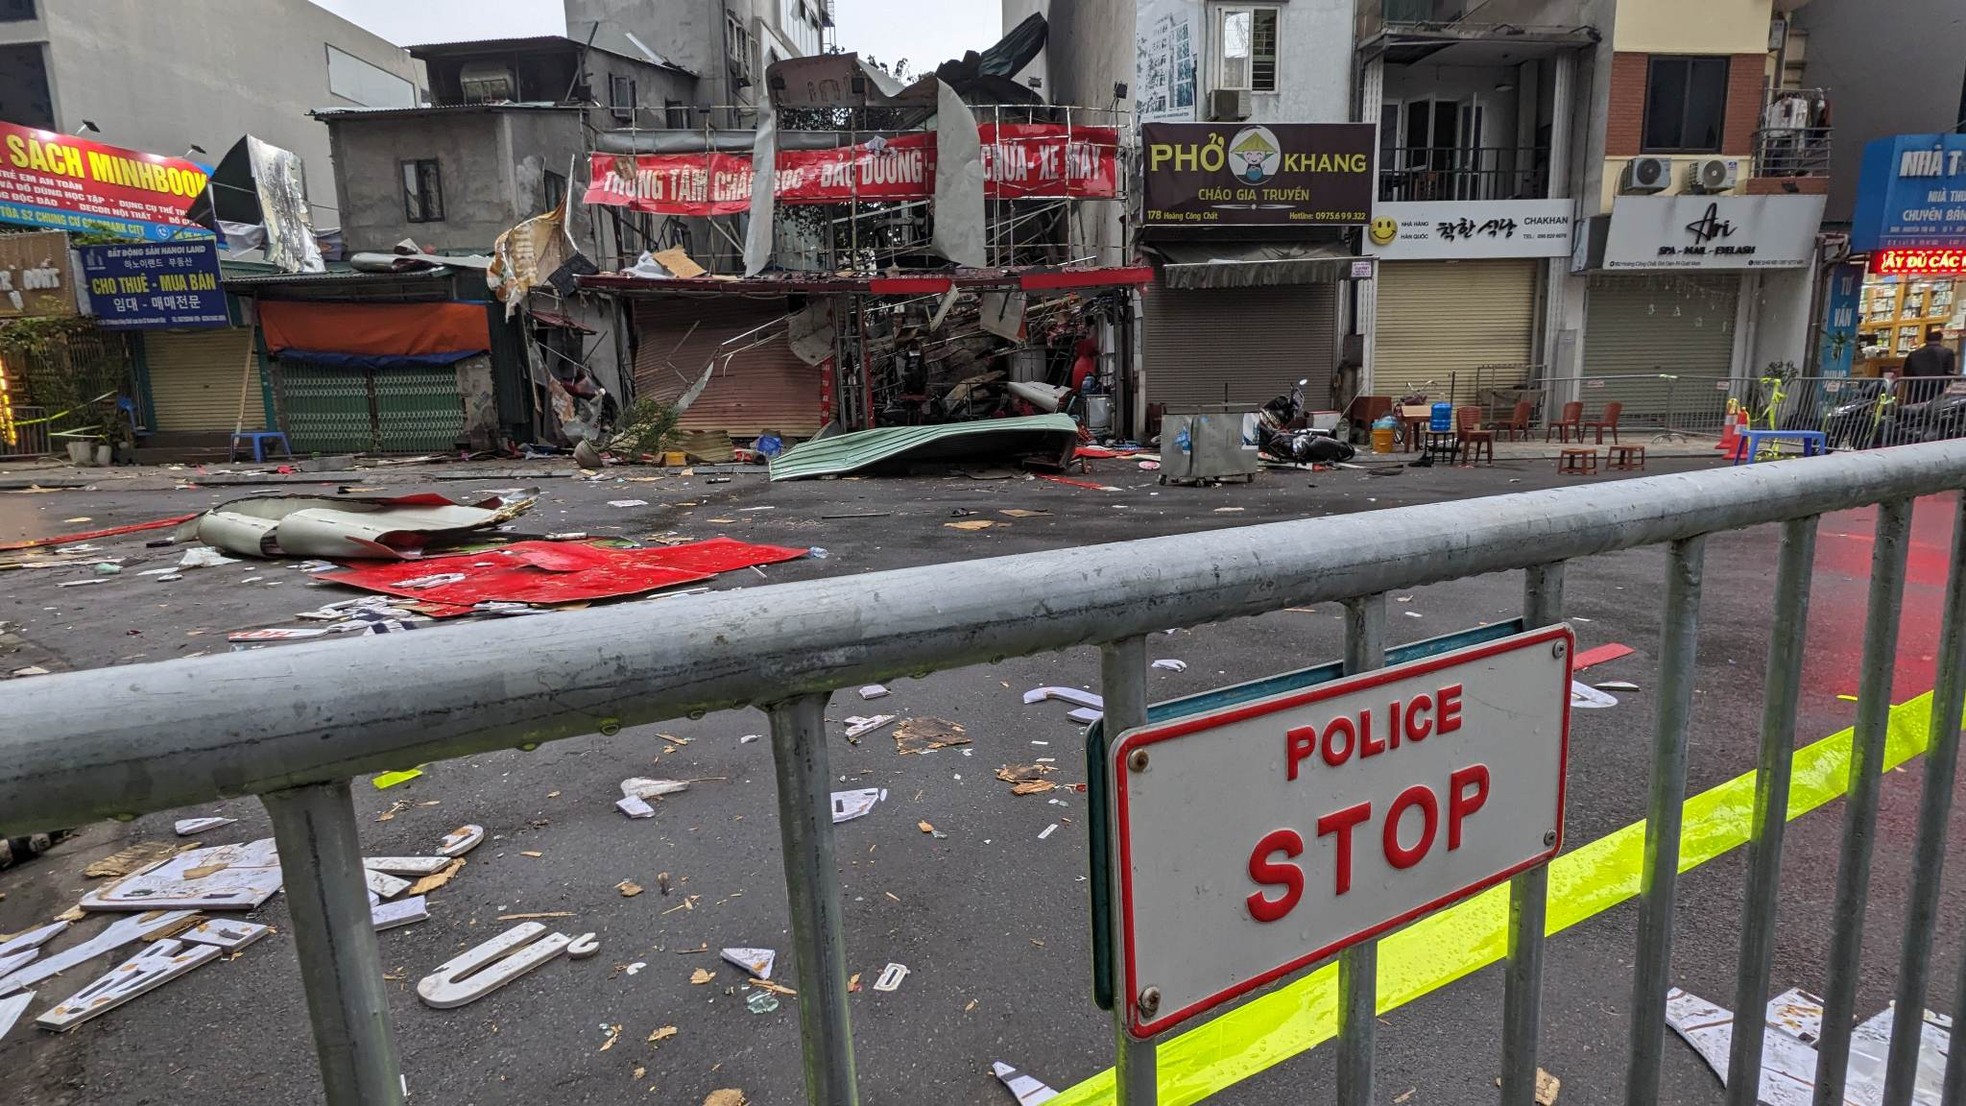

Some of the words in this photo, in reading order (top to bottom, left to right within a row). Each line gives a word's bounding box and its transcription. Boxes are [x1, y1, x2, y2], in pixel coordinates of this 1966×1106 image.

[6, 133, 85, 178] SÁCH
[1038, 144, 1060, 181] XE
[1065, 138, 1101, 181] MÁY
[1150, 132, 1225, 172] PHỞ
[1284, 153, 1367, 173] KHANG
[1899, 144, 1943, 177] NHÀ
[19, 173, 36, 183] EM
[39, 177, 54, 186] AN
[57, 179, 83, 191] TOÀN
[670, 164, 709, 202] TÂM
[1198, 186, 1232, 201] CHÁO
[1236, 189, 1257, 201] GIA
[1263, 185, 1310, 201] TRUYỀN
[1928, 187, 1947, 203] NHÀ
[64, 190, 85, 201] HỌC
[86, 194, 105, 204] TẬP
[176, 208, 188, 217] TH
[79, 202, 112, 215] DECOR
[21, 209, 34, 220] S2
[36, 211, 67, 223] CHUNG
[127, 223, 145, 237] CITY
[1148, 210, 1162, 220] 178
[1163, 210, 1184, 221] Hoàng
[1185, 211, 1201, 221] Công
[1203, 210, 1218, 220] Chất
[1289, 211, 1314, 220] Hotline:
[1523, 216, 1569, 225] CHAKHAN
[1685, 202, 1738, 245] Ari
[1903, 207, 1942, 222] CHUYÊN
[1476, 217, 1518, 240] 식당
[162, 246, 185, 254] HANOI
[186, 244, 206, 254] LAND
[1658, 246, 1676, 255] SPA
[124, 258, 164, 268] 하노이랜드
[1907, 251, 1928, 268] ĐỦ
[1928, 253, 1960, 268] CÁC
[92, 278, 117, 295] CHO
[118, 273, 150, 294] THUÊ
[159, 274, 188, 292] MUA
[189, 270, 217, 291] BÁN
[113, 297, 138, 312] 임대
[151, 295, 202, 310] 매매전문
[1286, 684, 1463, 782] POLICE
[1246, 762, 1491, 923] STOP
